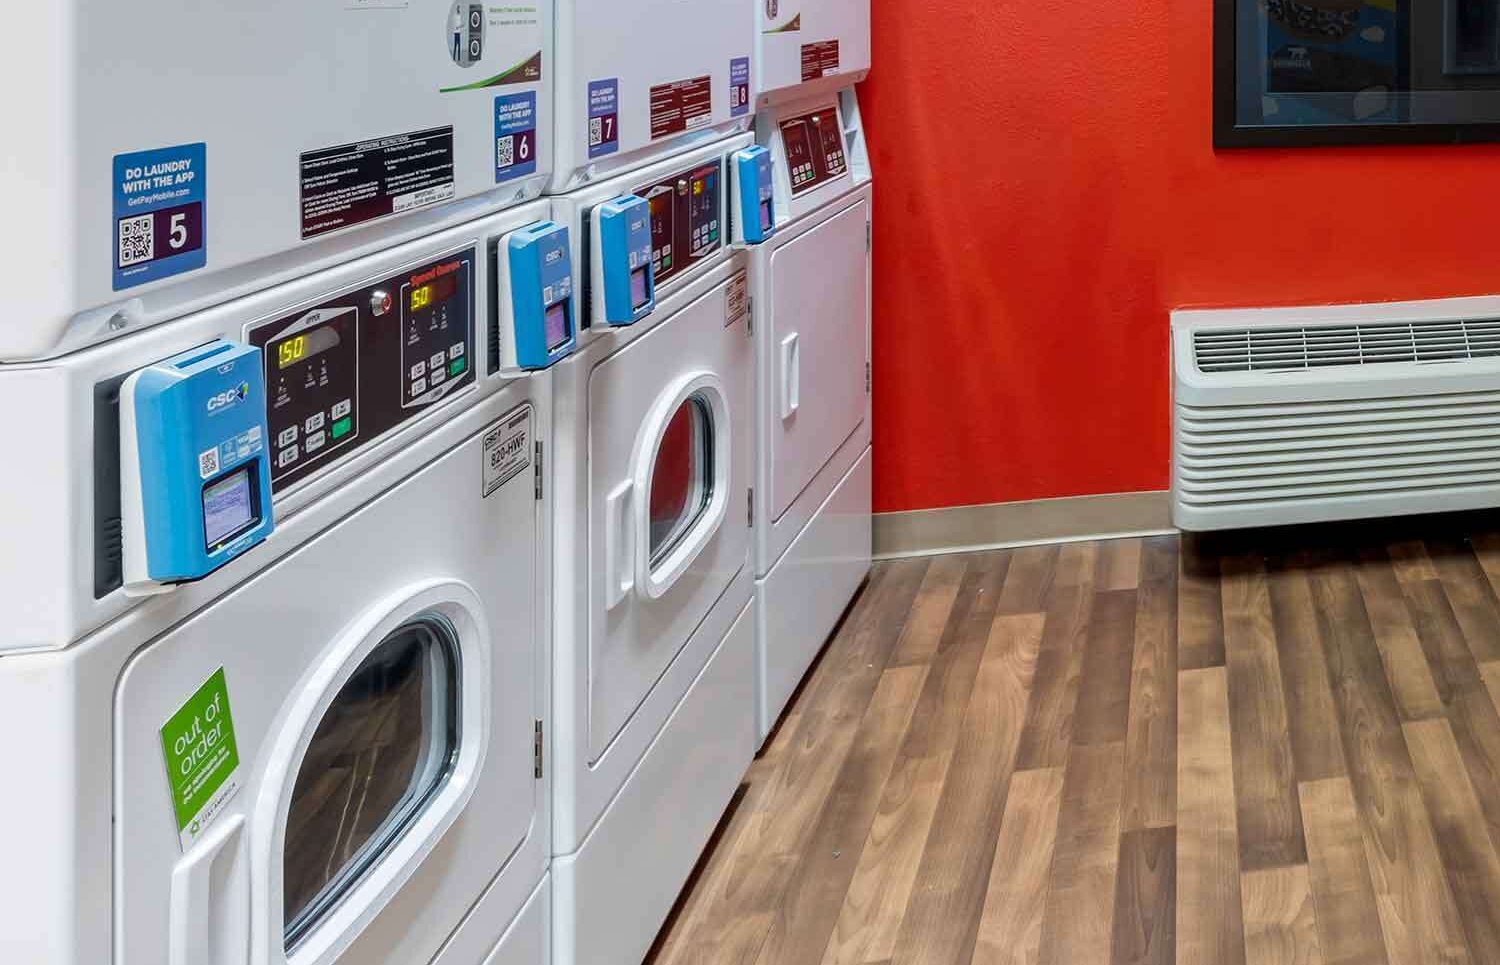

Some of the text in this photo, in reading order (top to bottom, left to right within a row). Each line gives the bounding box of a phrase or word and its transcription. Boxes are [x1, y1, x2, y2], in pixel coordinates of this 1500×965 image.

[605, 118, 613, 140] 7
[520, 135, 528, 159] 6
[125, 159, 192, 180] DO LAUNDRY
[122, 171, 195, 194] WITH THE APP
[128, 188, 191, 207] GetPayMobile.com
[169, 213, 188, 249] 5
[207, 389, 236, 411] CSC
[491, 432, 525, 467] 820-HWF
[175, 716, 202, 755] out
[205, 692, 220, 722] of
[181, 720, 222, 774] order
